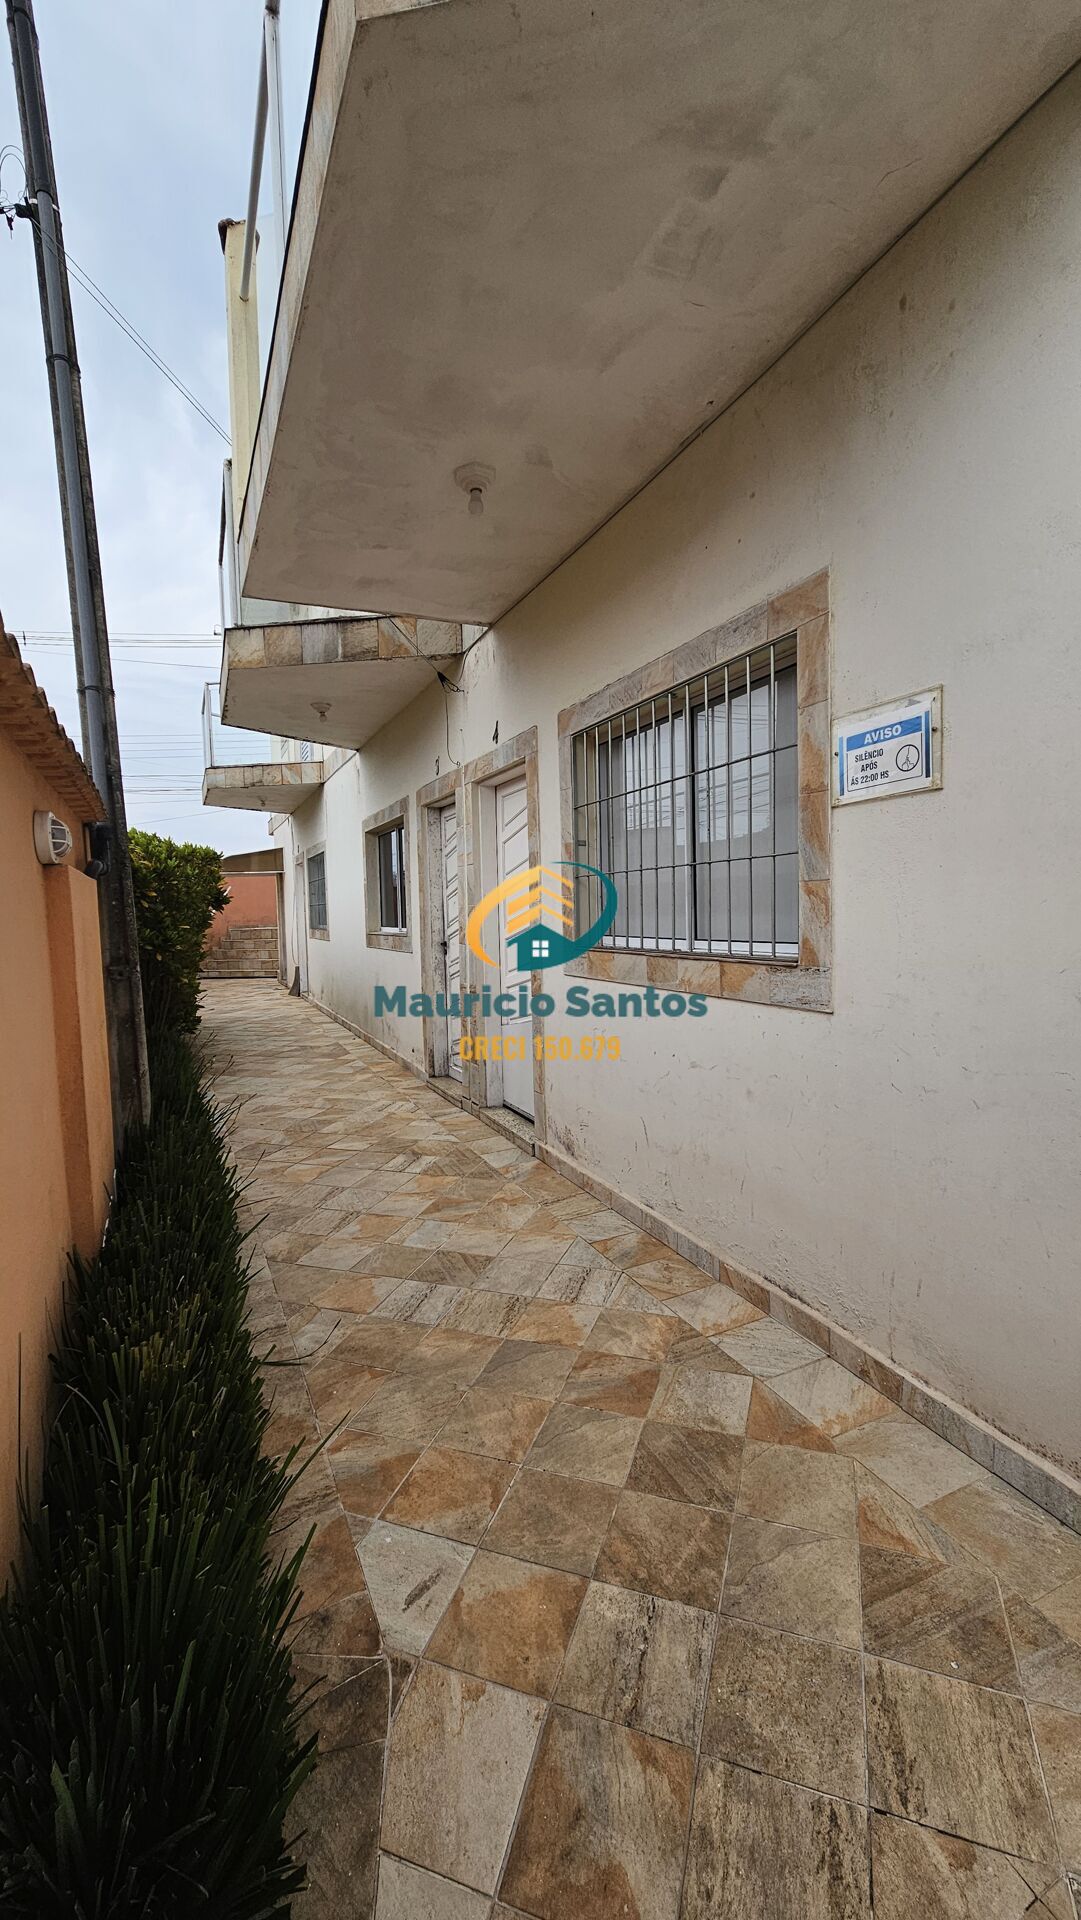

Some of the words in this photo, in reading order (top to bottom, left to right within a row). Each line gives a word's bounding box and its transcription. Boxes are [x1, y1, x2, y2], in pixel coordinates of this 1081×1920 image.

[864, 724, 902, 745] AVISO
[855, 749, 884, 763] SILÊNCIO
[861, 760, 878, 772] APÓS
[860, 772, 879, 784] 22:00
[880, 770, 889, 780] HS
